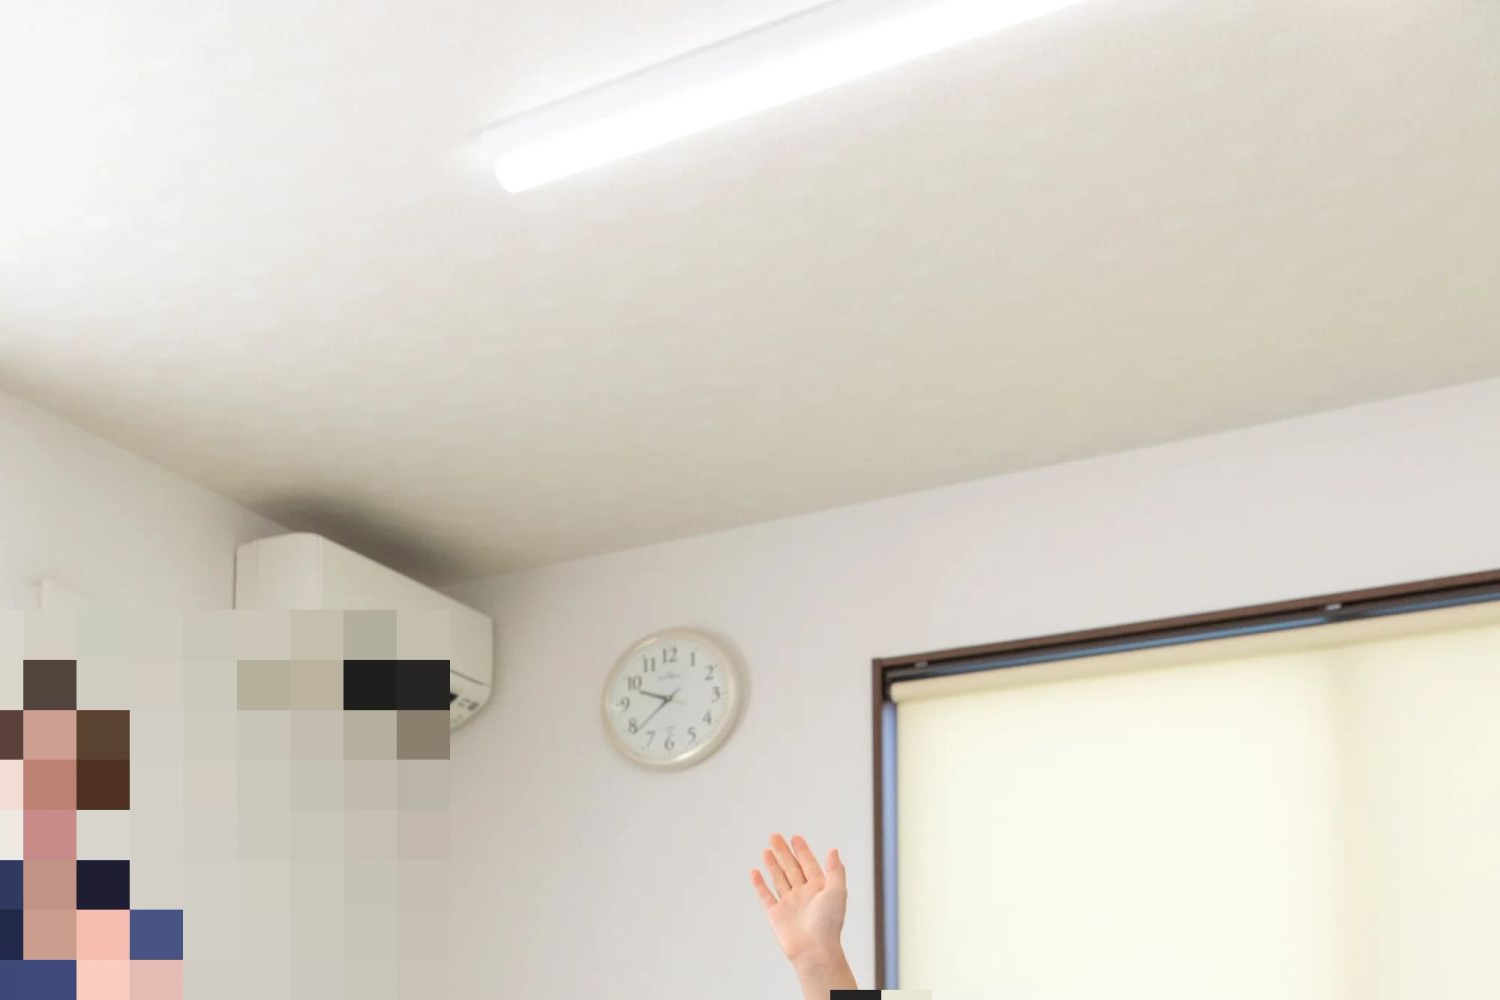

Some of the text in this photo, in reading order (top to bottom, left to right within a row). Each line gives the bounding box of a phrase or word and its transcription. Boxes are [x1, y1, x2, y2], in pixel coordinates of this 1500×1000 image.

[662, 647, 678, 663] 12
[643, 657, 656, 672] 11
[704, 665, 714, 681] 2
[627, 675, 642, 691] 10
[711, 686, 721, 702] 3
[620, 697, 631, 712] 9
[702, 710, 712, 725] 4
[628, 718, 638, 734] 8
[646, 731, 656, 747] 7
[664, 735, 675, 750] 6
[687, 727, 697, 743] 5
